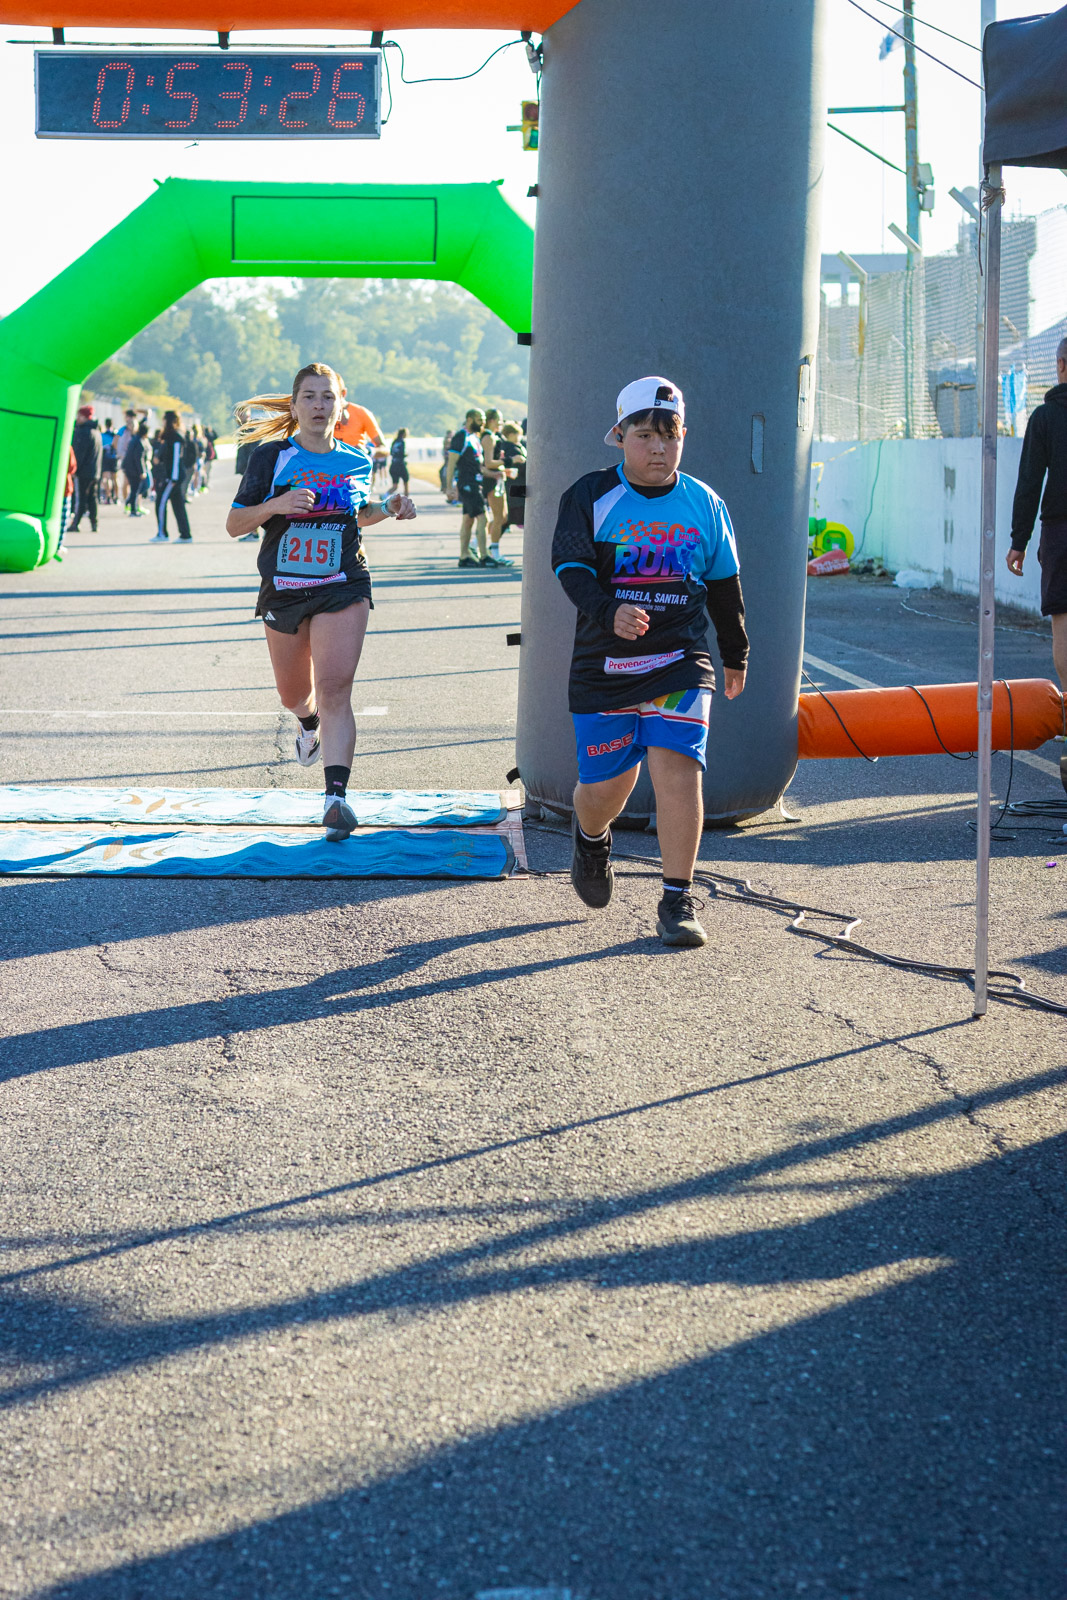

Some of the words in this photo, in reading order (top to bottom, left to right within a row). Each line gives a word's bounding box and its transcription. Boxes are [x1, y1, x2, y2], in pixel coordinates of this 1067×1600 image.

[92, 62, 366, 128] 0:53:26
[290, 486, 351, 511] UN
[649, 521, 700, 551] 500
[288, 537, 329, 564] 215
[614, 544, 690, 576] RUN
[615, 588, 652, 603] RAFAELA,
[654, 592, 680, 604] SANTA
[679, 594, 689, 605] FE
[587, 731, 634, 757] BASE
